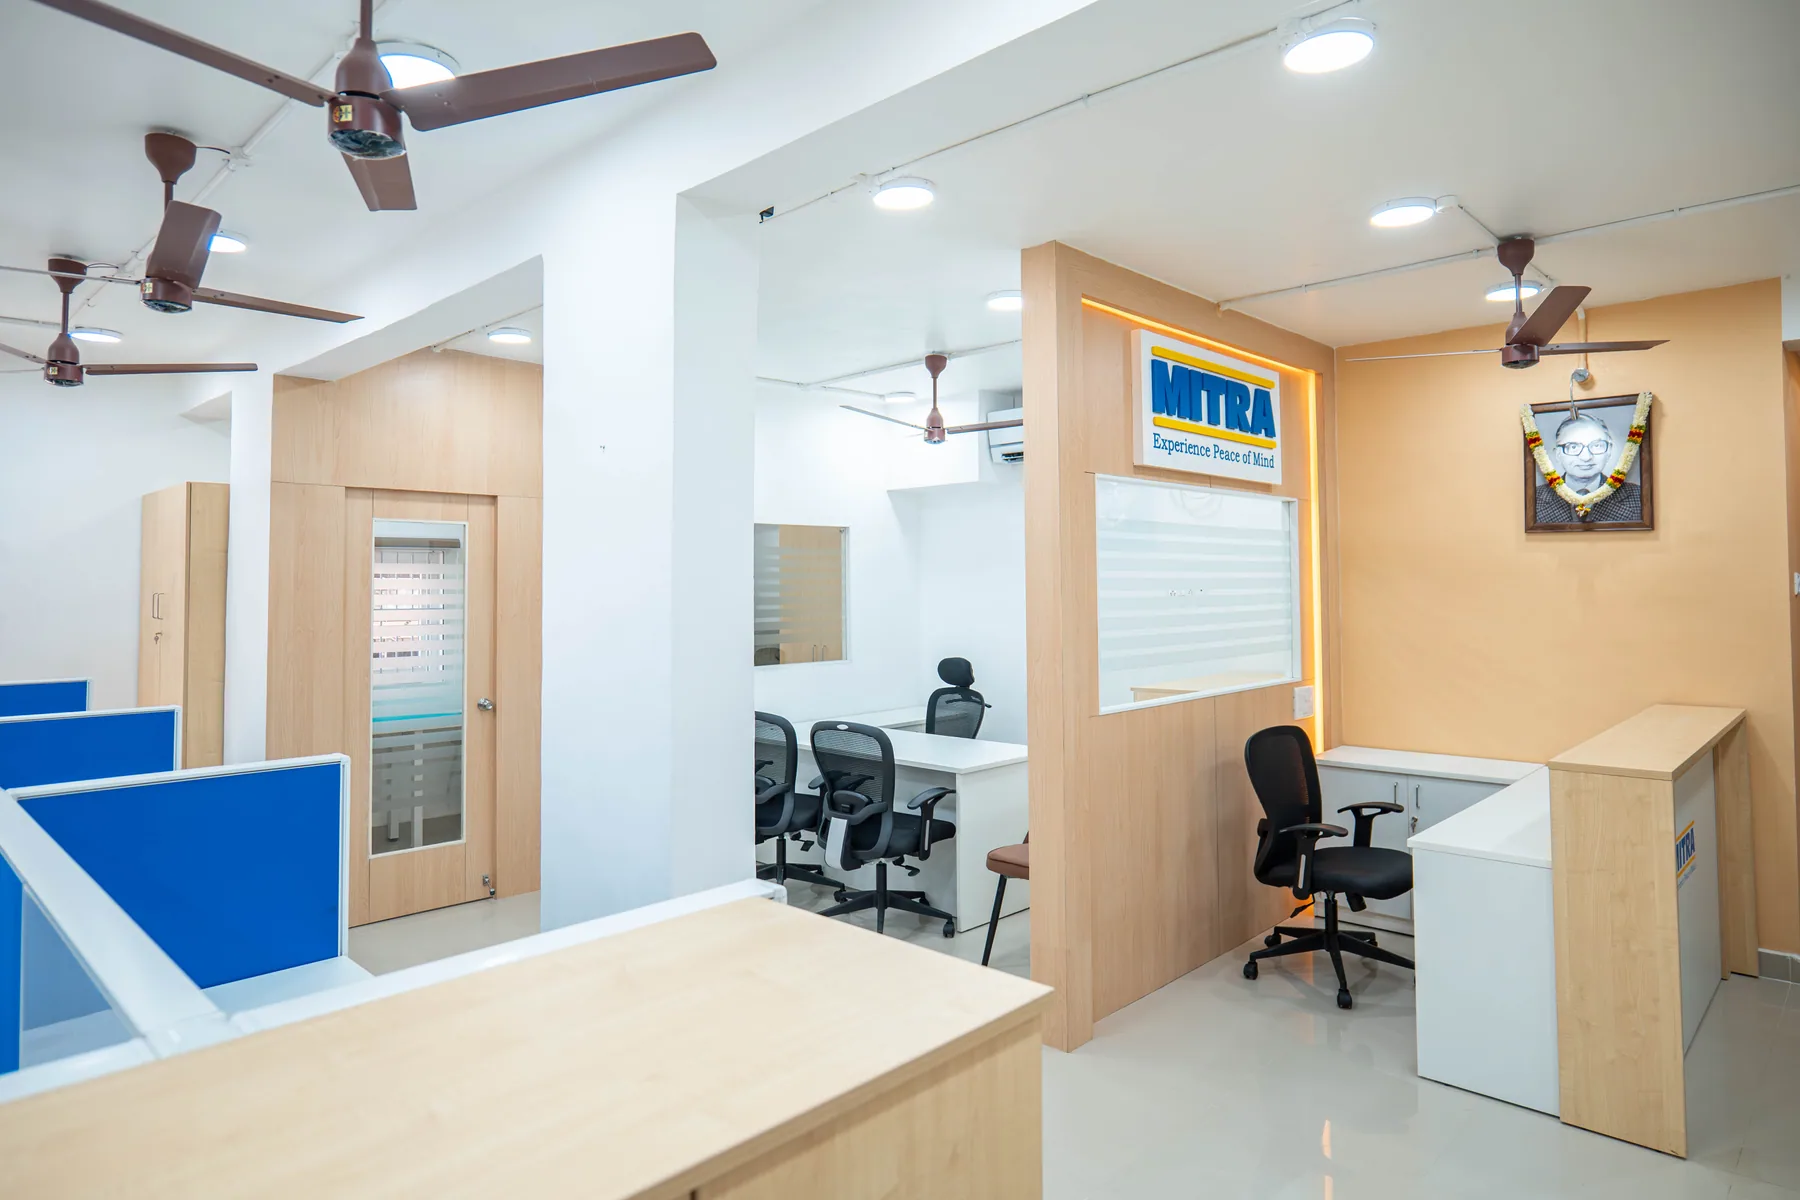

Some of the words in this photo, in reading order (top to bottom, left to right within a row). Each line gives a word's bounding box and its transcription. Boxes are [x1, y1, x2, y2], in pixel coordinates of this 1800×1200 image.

[1151, 359, 1276, 438] MITRA
[1153, 432, 1210, 458] Experience
[1213, 444, 1240, 463] Peace
[1242, 450, 1251, 465] of
[1253, 451, 1275, 469] Mind
